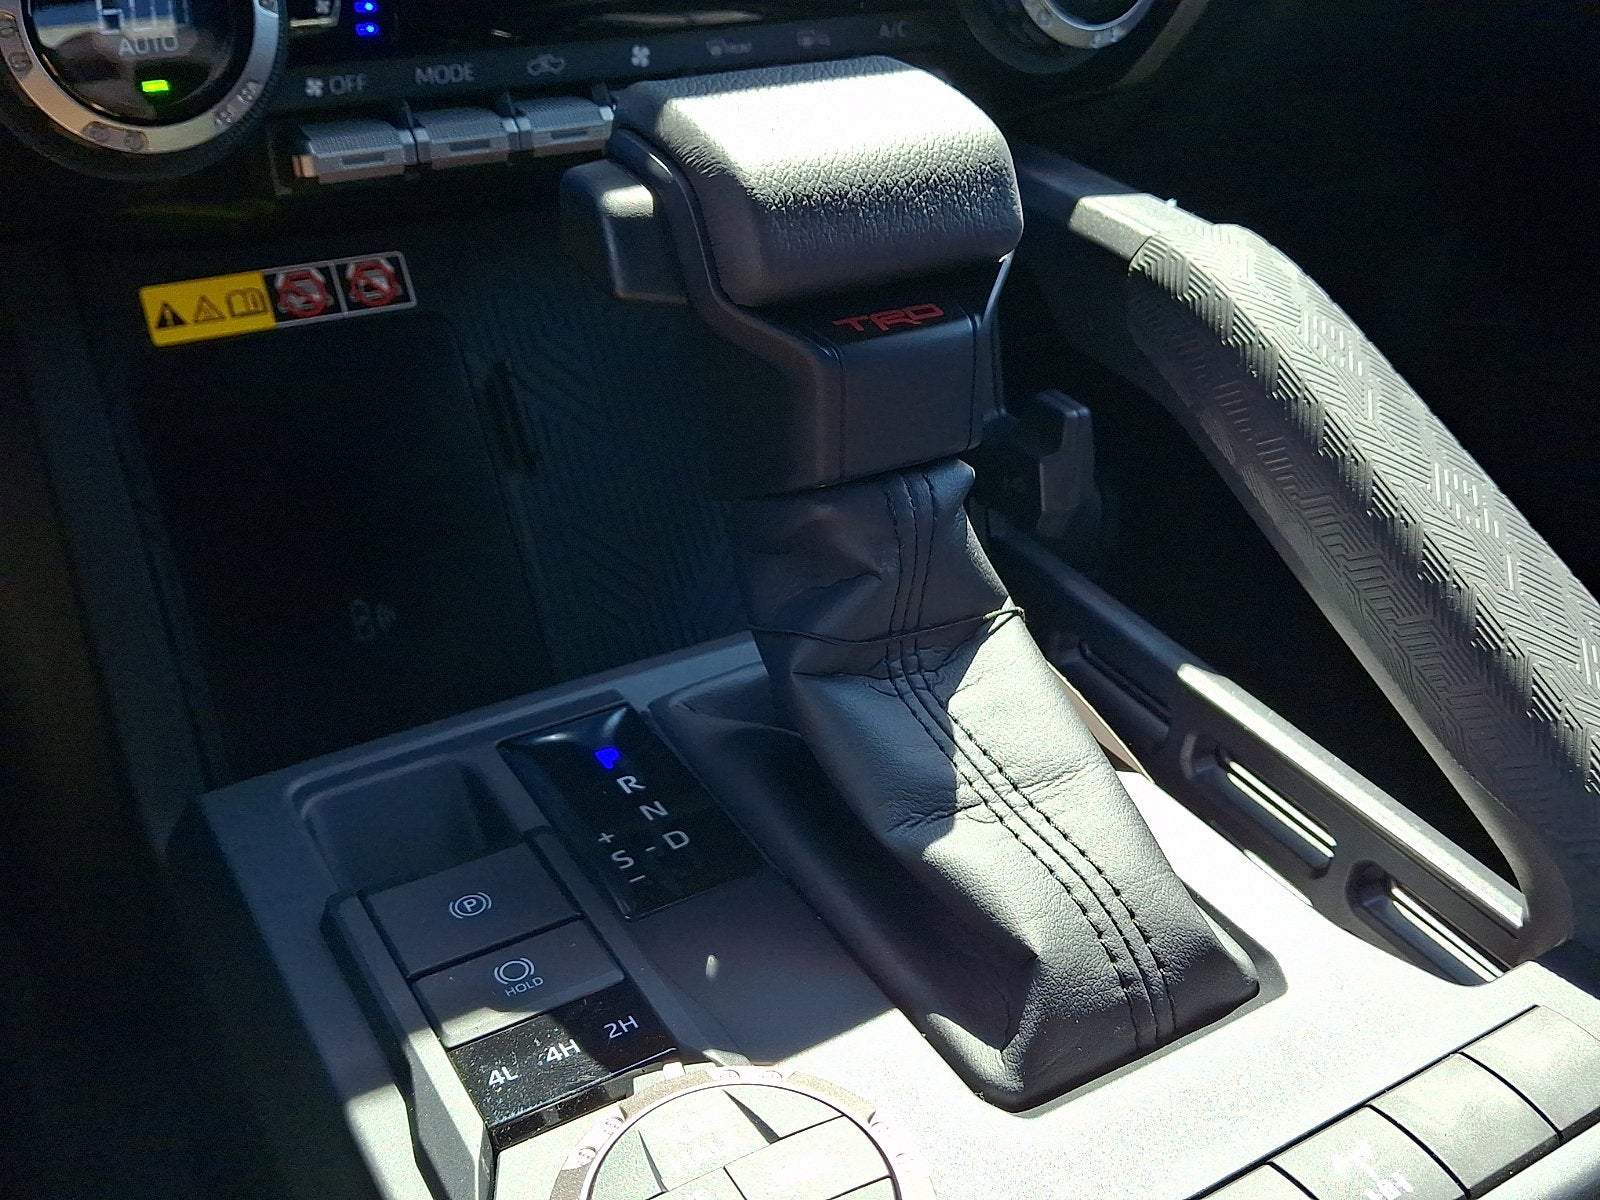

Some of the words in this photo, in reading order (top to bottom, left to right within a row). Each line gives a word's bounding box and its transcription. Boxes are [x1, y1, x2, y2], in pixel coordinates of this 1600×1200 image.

[118, 36, 179, 55] AUTO
[329, 73, 367, 95] OFF
[414, 62, 476, 85] MODE
[832, 303, 944, 332] TRD
[616, 775, 646, 794] R
[638, 800, 669, 821] N
[662, 830, 690, 850] D
[611, 850, 634, 869] S
[465, 898, 477, 912] P
[505, 976, 544, 997] HOLD
[604, 1015, 639, 1040] 2H
[546, 1039, 581, 1063] 4H
[488, 1066, 519, 1088] 4L
